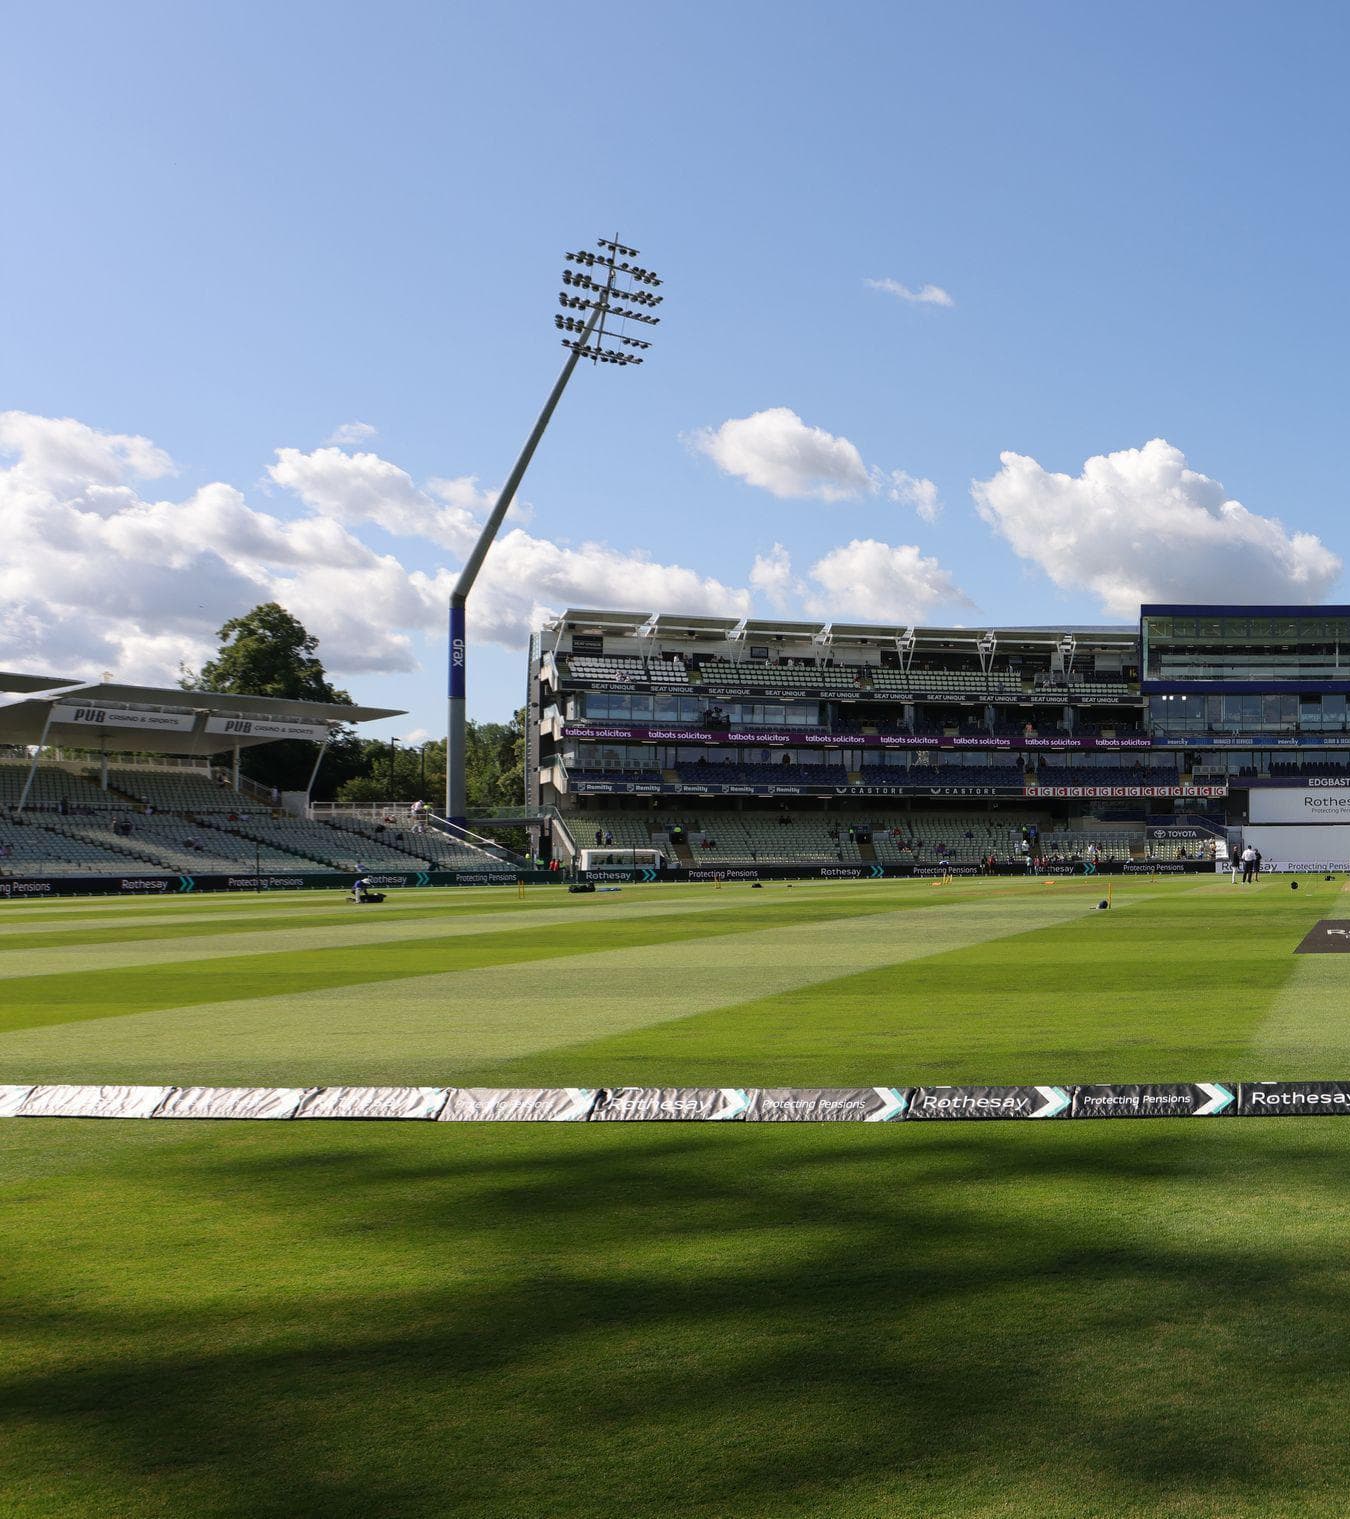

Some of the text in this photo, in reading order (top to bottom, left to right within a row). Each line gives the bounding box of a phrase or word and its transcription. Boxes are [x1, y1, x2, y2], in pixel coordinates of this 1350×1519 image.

[452, 638, 464, 666] drax
[74, 709, 106, 723] PUB
[148, 717, 178, 726] SPORTS
[225, 720, 250, 733] PUB
[565, 728, 631, 738] talbots solicitors
[648, 730, 712, 740] talbots solicitors
[728, 733, 790, 742] talbots solicitors
[806, 735, 864, 744] talbots solicitors
[880, 736, 938, 744] talbots solicitors
[953, 737, 1010, 745] talbots solicitors
[1025, 738, 1080, 746] talbots solicitors
[1096, 738, 1151, 746] talbots solicitors
[586, 784, 612, 792] Remitly
[636, 784, 660, 792] Remitly
[777, 786, 800, 794] Remitly
[913, 866, 977, 875] Protecting Pensions
[1124, 864, 1155, 872] Protecting
[1289, 863, 1325, 871] Protecting
[586, 872, 631, 881] Rothesay
[689, 870, 724, 879] Protecting
[821, 868, 861, 877] Rothesay
[228, 877, 303, 888] Protecting Pensions
[368, 874, 407, 885] Rothesay
[456, 874, 487, 882] Protecting
[13, 882, 50, 891] Pensions
[121, 879, 168, 890] Rothesay
[922, 1096, 1029, 1110] Rothesay
[1084, 1094, 1190, 1106] Protecting Pensions
[609, 1098, 706, 1112] Rothesay
[762, 1100, 866, 1111] Protecting Pensions
